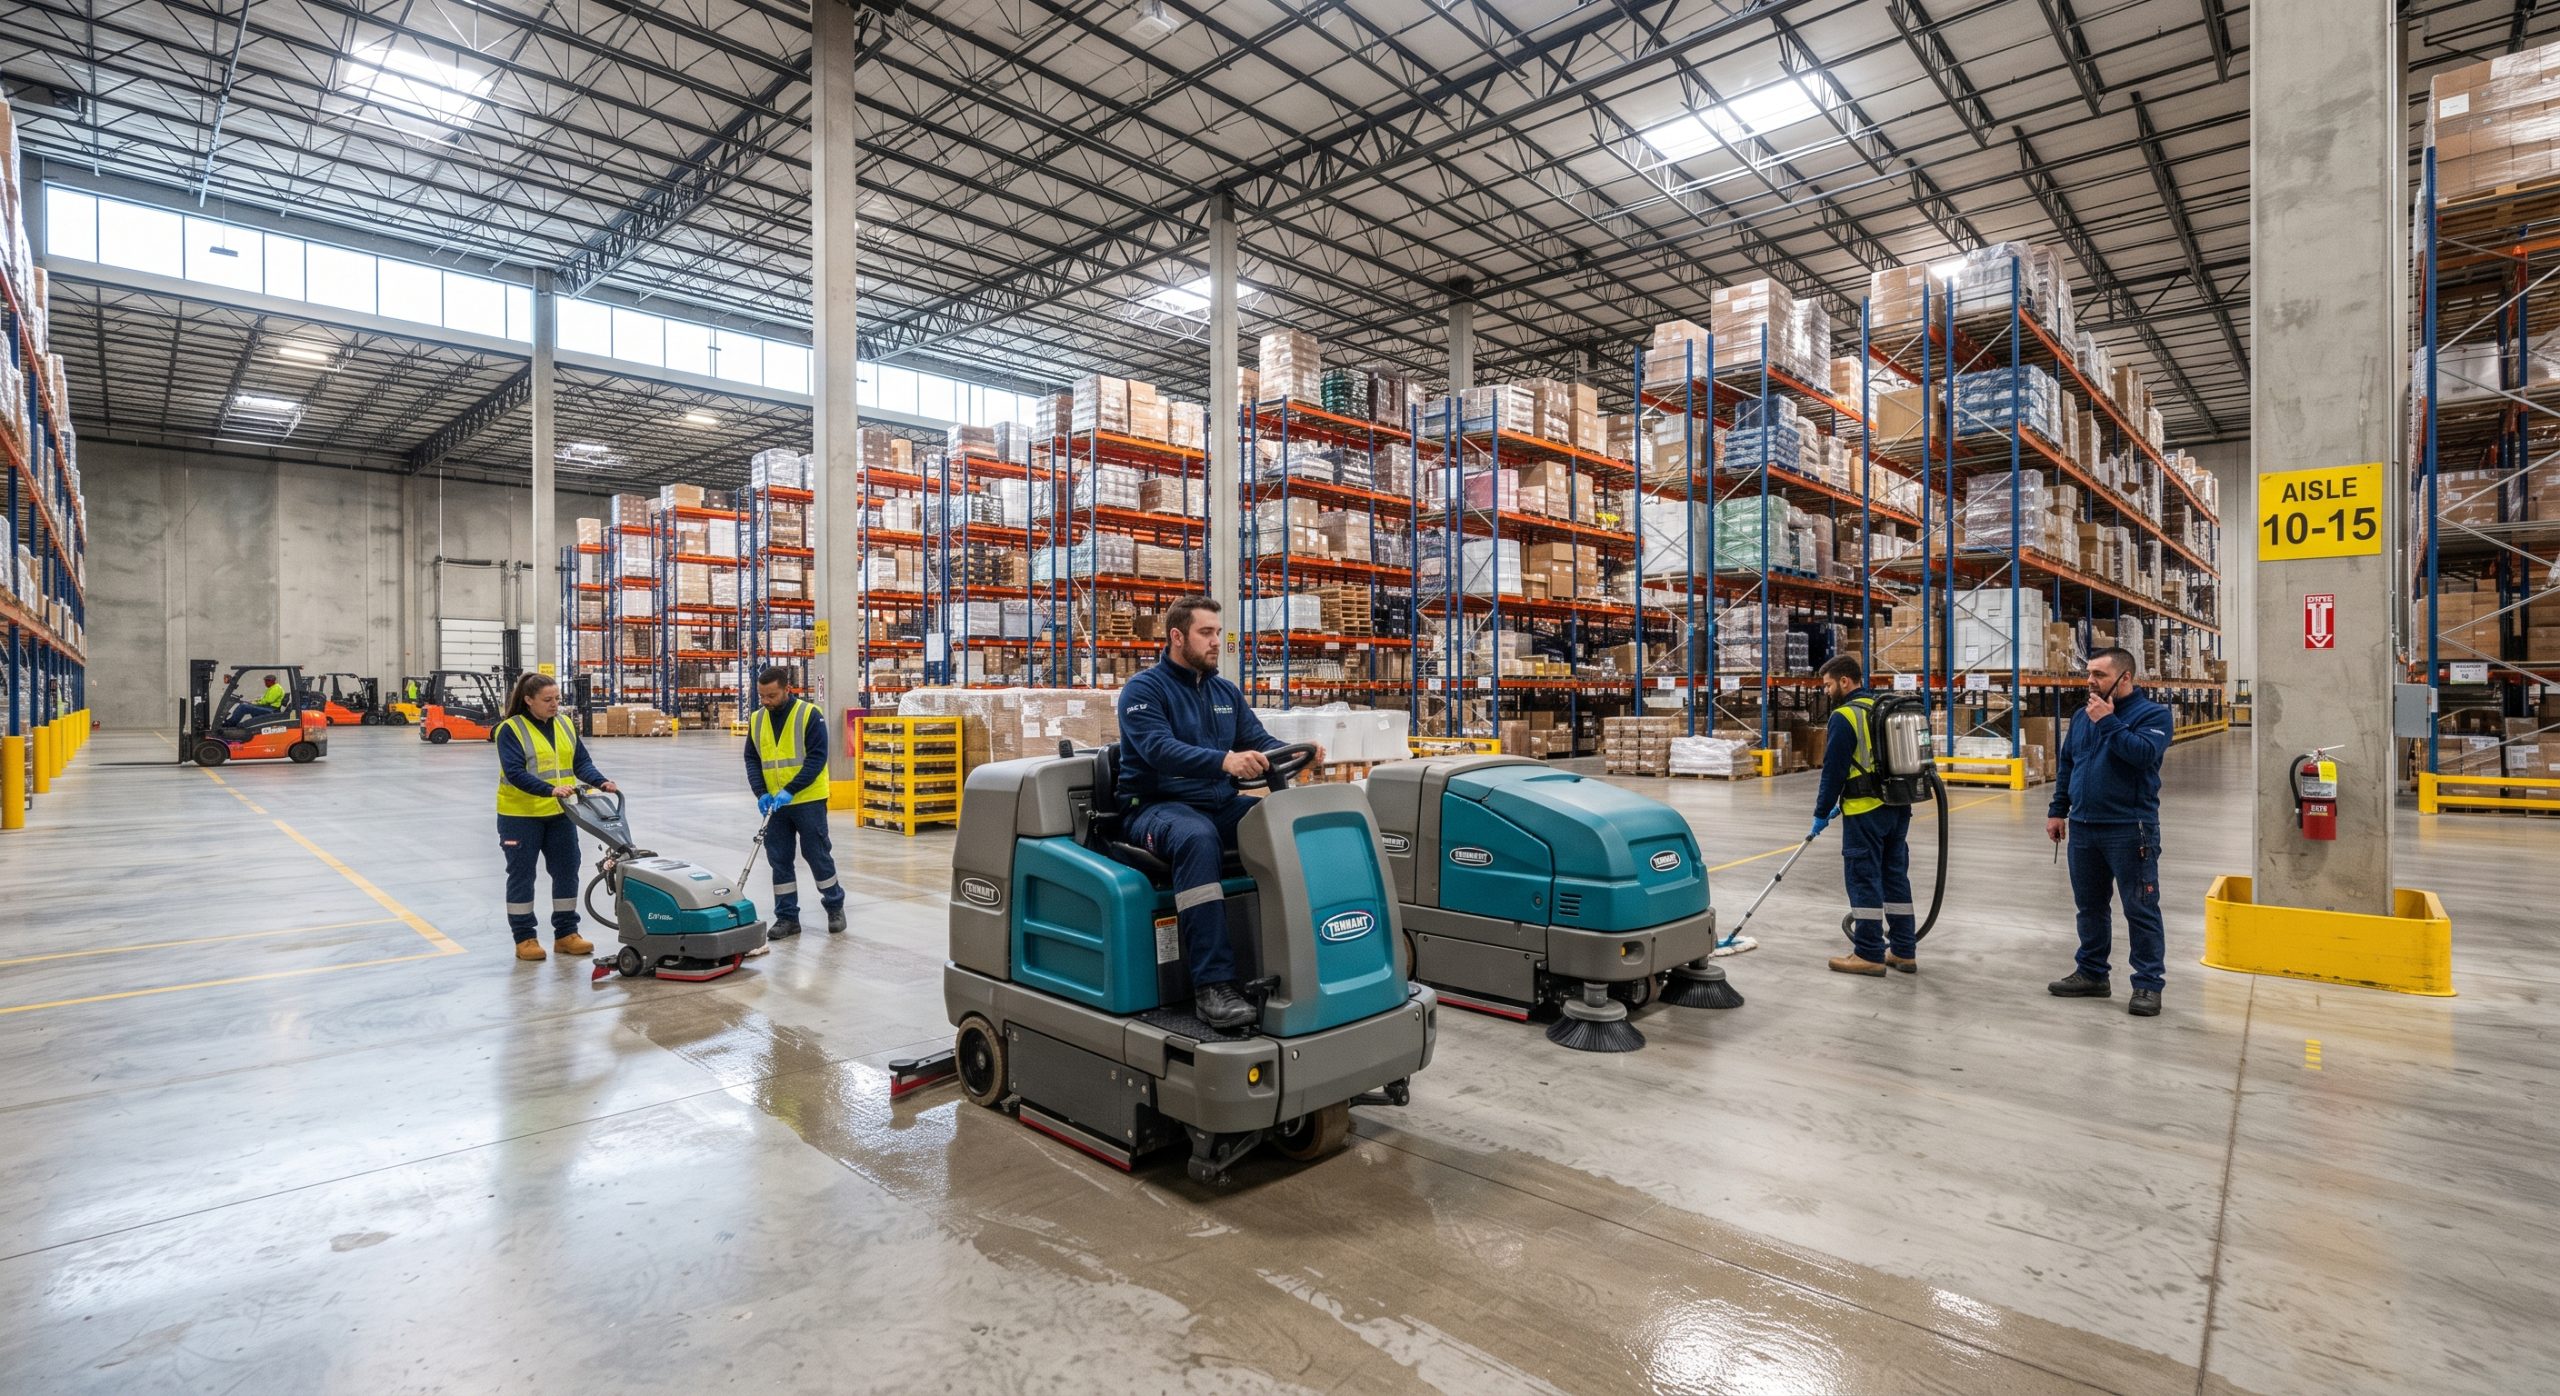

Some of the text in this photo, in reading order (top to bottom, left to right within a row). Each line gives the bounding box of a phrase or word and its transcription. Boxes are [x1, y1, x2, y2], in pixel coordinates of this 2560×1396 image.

[2281, 476, 2358, 504] AISLE
[2263, 506, 2377, 546] 10-15
[1327, 916, 1368, 938] TENNANT
